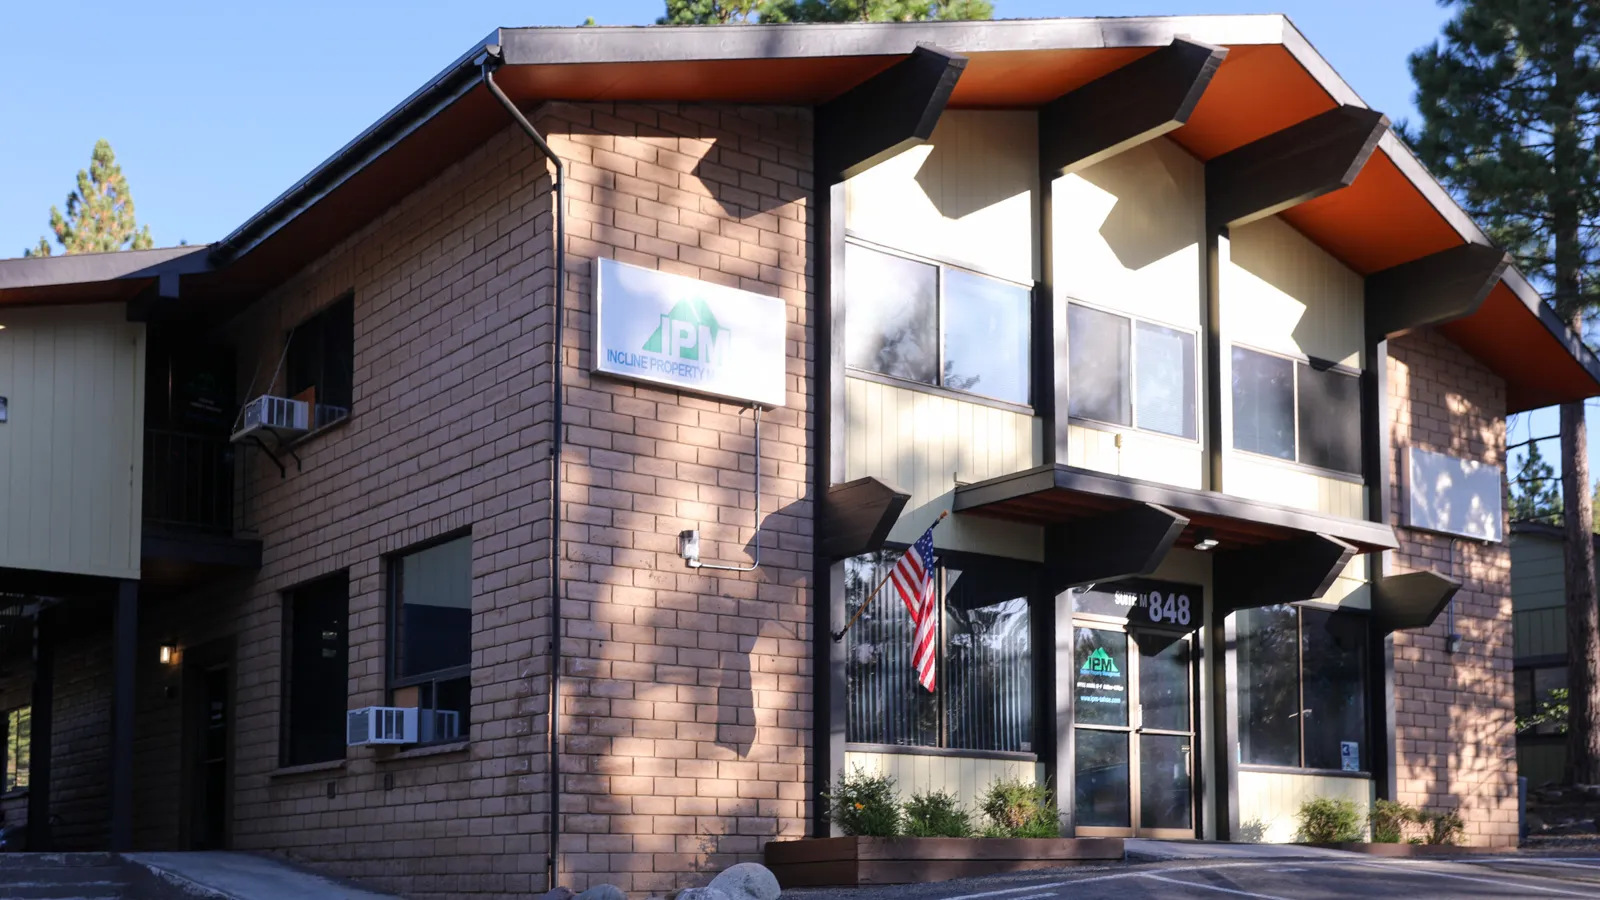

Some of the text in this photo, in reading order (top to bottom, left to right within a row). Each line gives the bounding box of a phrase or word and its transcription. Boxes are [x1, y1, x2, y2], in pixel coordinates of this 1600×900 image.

[662, 316, 729, 366] IPM
[607, 348, 648, 369] INCLINE
[650, 357, 705, 380] PROPERTY
[1139, 594, 1148, 608] M
[1149, 591, 1191, 625] 848
[1088, 657, 1112, 672] IPM
